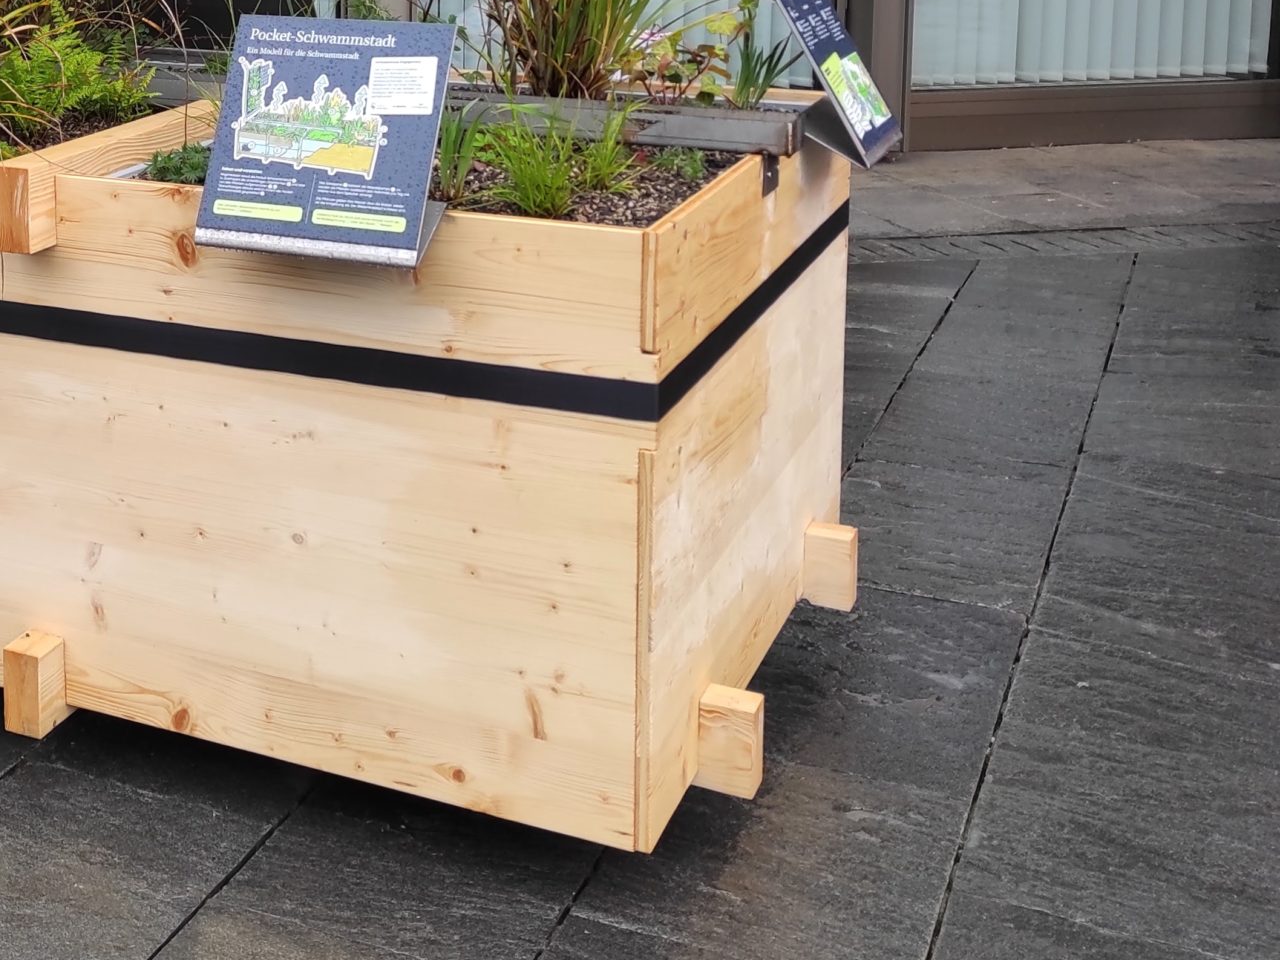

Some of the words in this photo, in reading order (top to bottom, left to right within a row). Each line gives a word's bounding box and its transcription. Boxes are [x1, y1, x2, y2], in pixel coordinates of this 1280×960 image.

[250, 28, 397, 48] Pocket-Schwammstadt
[247, 46, 258, 54] Ein
[259, 47, 283, 56] Modell
[283, 47, 295, 57] für
[295, 48, 306, 57] die
[307, 49, 360, 60] Schwammstadt
